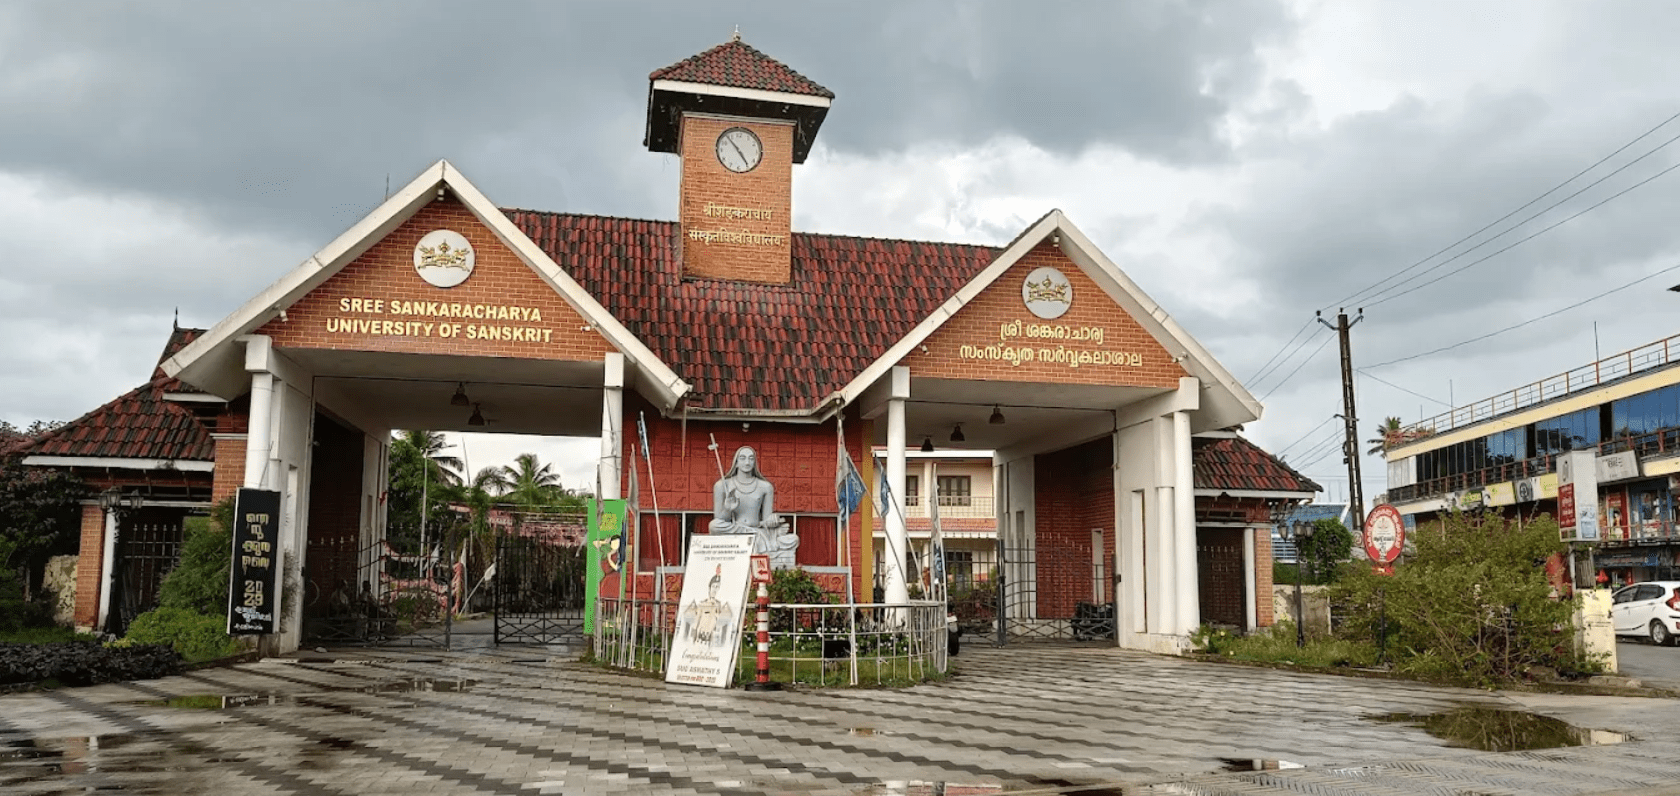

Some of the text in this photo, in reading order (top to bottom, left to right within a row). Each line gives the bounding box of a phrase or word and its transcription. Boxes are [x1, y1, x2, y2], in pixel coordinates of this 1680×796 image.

[339, 297, 542, 322] SREE SANKARACHARYA
[326, 317, 553, 343] UNIVERSITY OF SANSKRIT
[1000, 319, 1104, 345] ശ്രീ ശങ്കരാചാര്യ
[959, 342, 1034, 367] സംസ്കൃത
